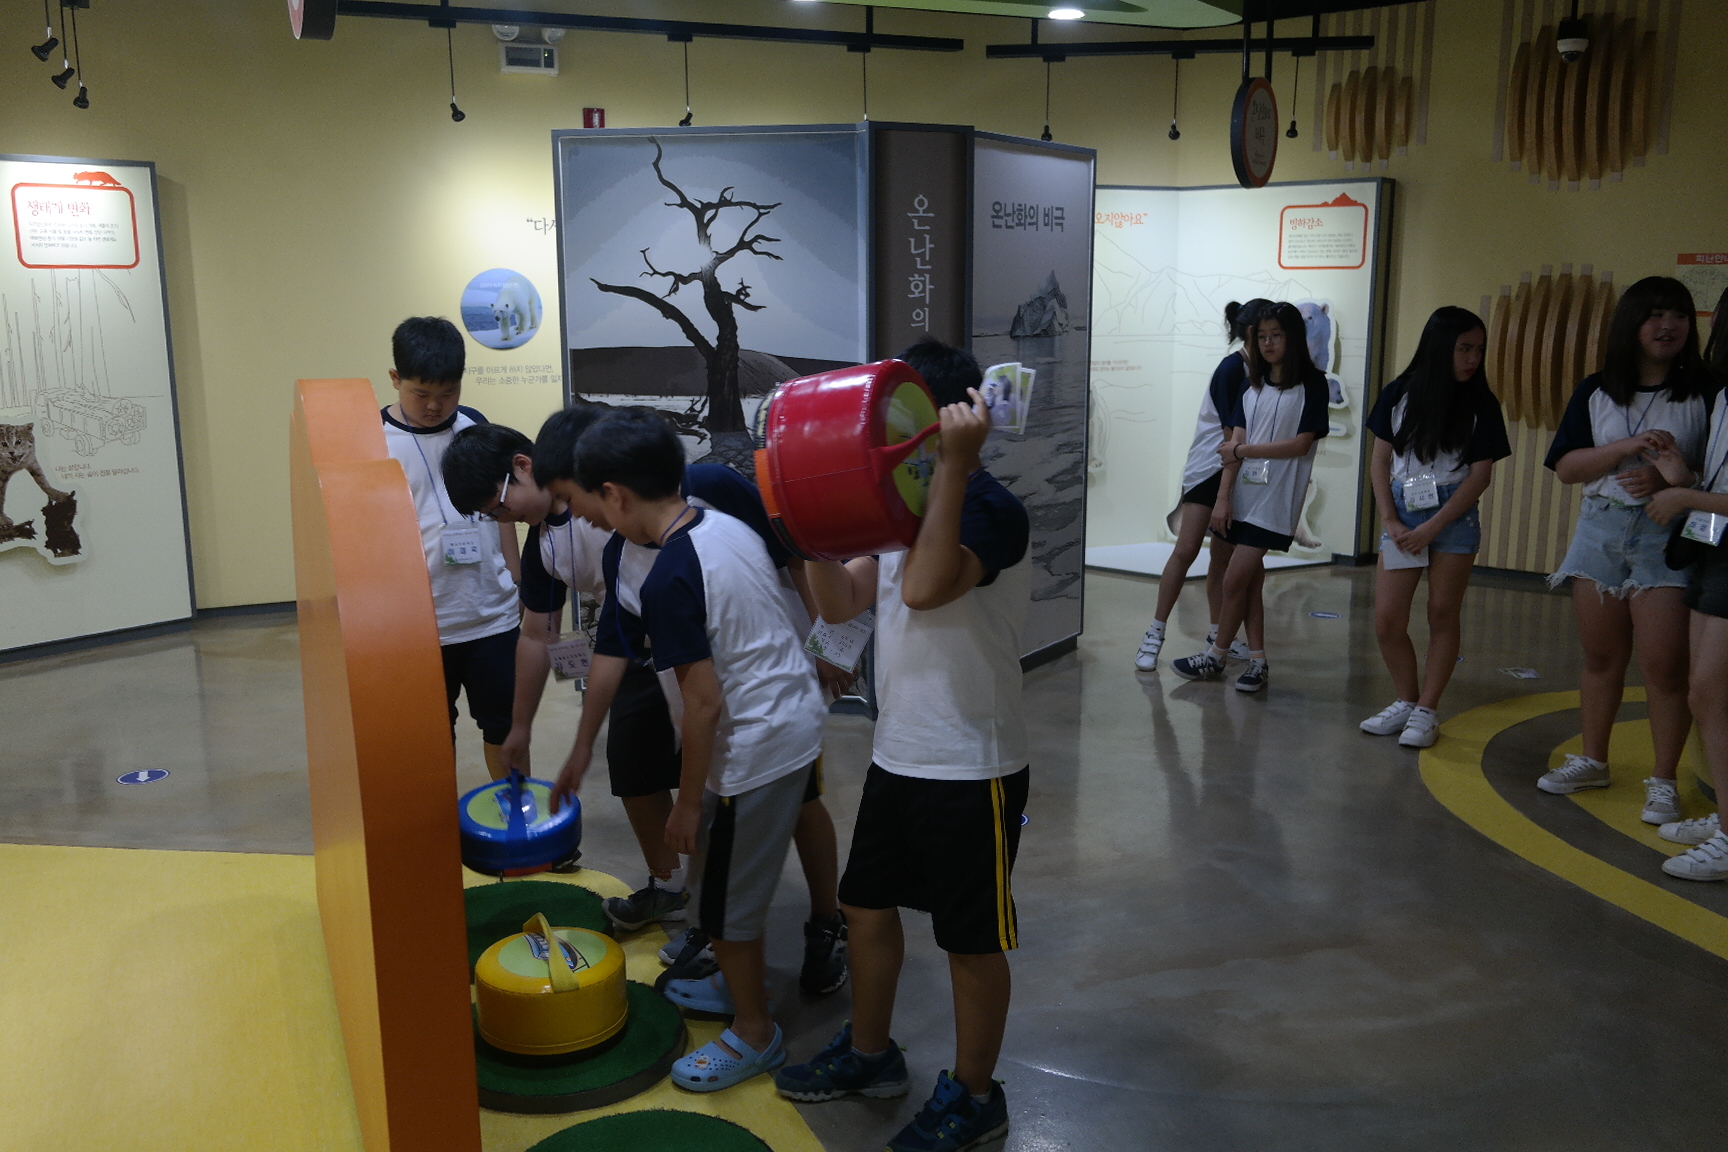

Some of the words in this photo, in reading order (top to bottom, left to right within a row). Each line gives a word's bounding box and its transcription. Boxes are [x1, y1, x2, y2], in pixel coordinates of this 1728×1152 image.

[26, 200, 64, 217] 생태계
[67, 202, 92, 217] 변화
[990, 201, 1039, 231] 온난화의
[1043, 205, 1066, 233] 비극
[1289, 218, 1324, 231] 빙하감소
[907, 195, 935, 332] 온난화의
[509, 365, 523, 374] 하지
[475, 376, 497, 386] 우리는
[498, 376, 519, 386] 소중한
[521, 375, 549, 385] 누군가를
